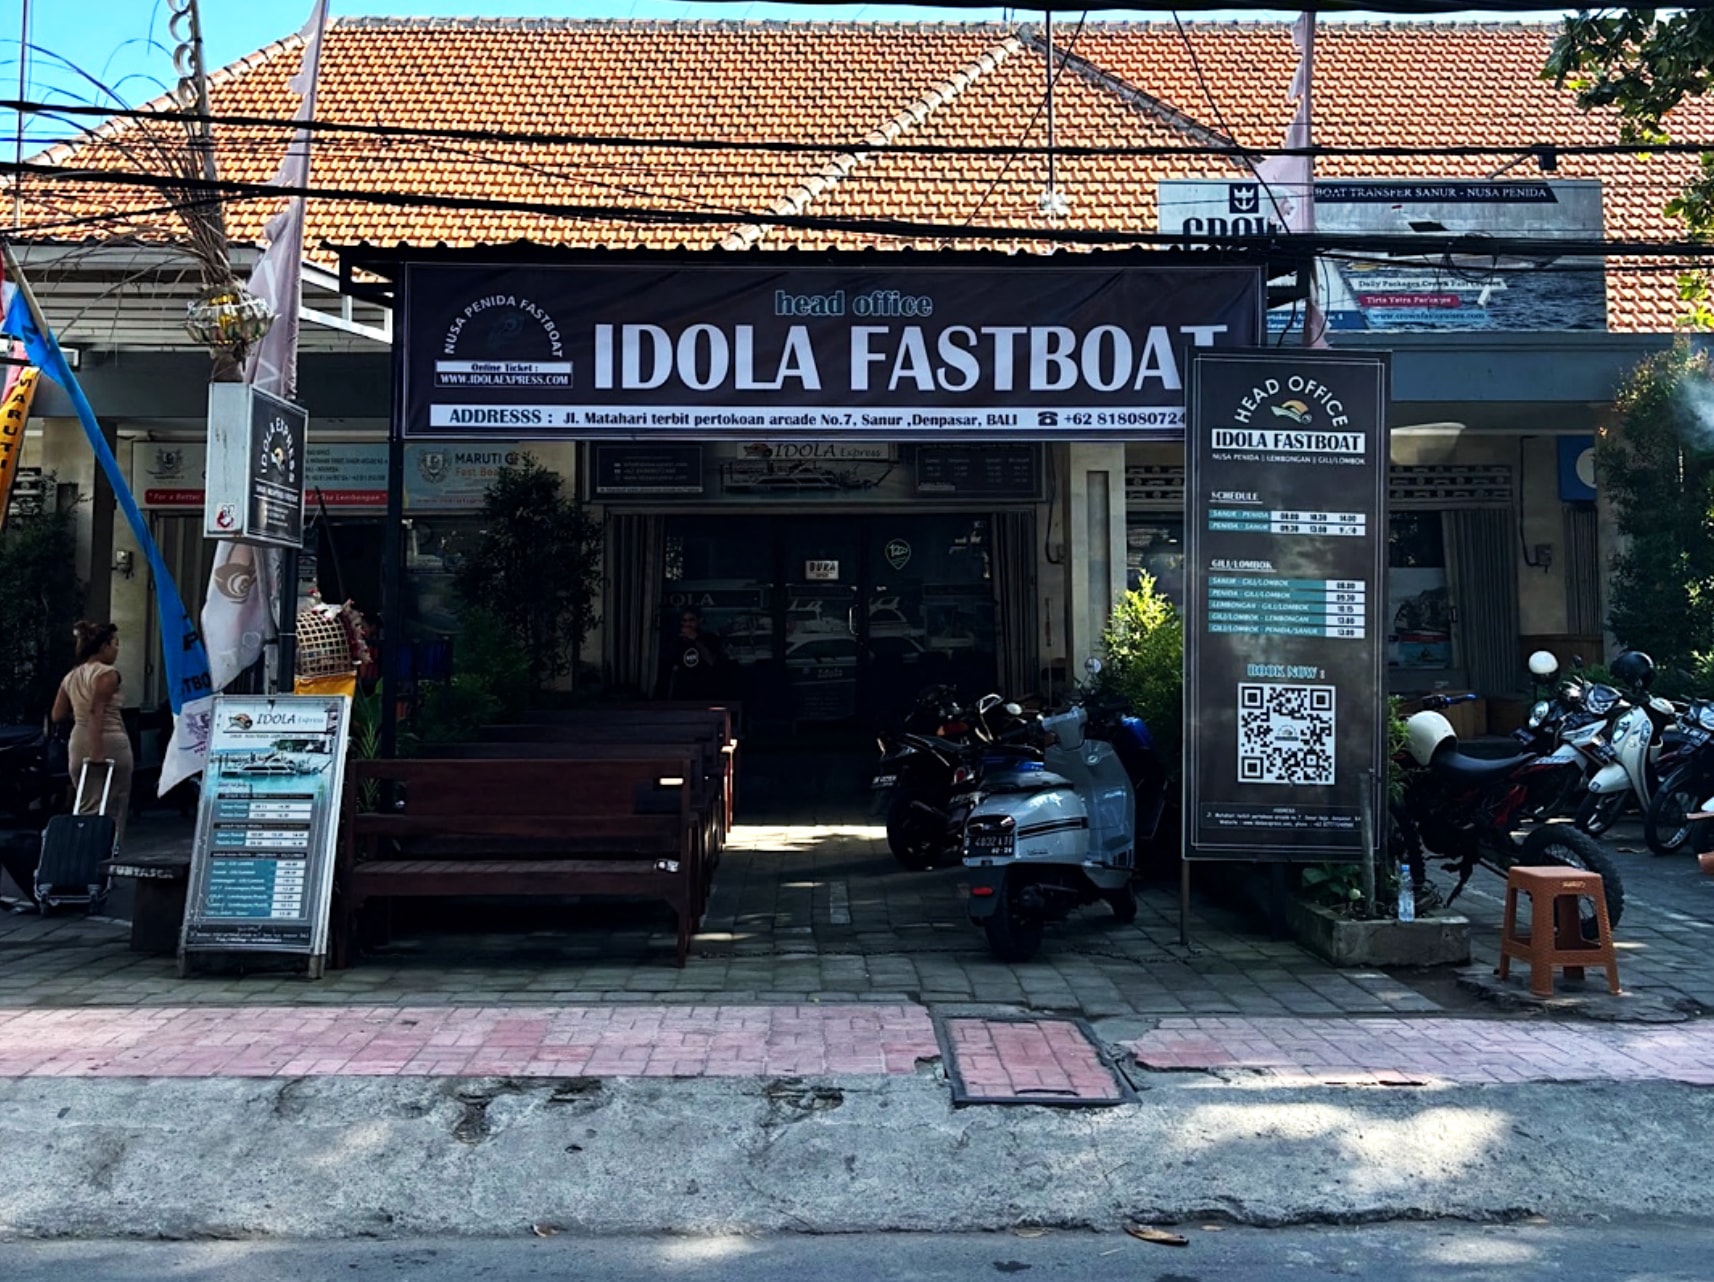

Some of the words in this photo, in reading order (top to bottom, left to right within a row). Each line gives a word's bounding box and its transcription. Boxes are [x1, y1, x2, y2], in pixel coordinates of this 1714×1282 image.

[1350, 187, 1412, 197] TRANSFER
[1415, 187, 1457, 197] SANUR
[1467, 187, 1499, 198] NUSA
[1502, 187, 1547, 198] PENIDA
[775, 290, 845, 317] head
[852, 290, 934, 317] office
[443, 316, 467, 355] NUSA
[464, 294, 516, 318] PENIDA
[518, 298, 563, 358] FASTBOAT
[594, 323, 822, 391] IDOLA
[470, 363, 501, 372] Online
[505, 363, 533, 372] Ticket
[439, 373, 569, 385] WWW.IDOLAEXPRESS.COM
[1234, 378, 1280, 424] HEAD
[1288, 375, 1349, 428] OFFICE
[449, 409, 542, 424] ADDRESSS
[584, 412, 647, 425] Matahari
[651, 412, 689, 425] terbit
[694, 413, 765, 428] pertokoan
[769, 413, 817, 425] arcade
[861, 414, 903, 426] Sanur
[986, 414, 1018, 426] BALI
[1063, 413, 1092, 425] +62
[1215, 430, 1268, 448] IDOLA
[1273, 432, 1361, 451] FASTBOAT
[775, 443, 836, 458] IDOLA
[455, 452, 501, 465] MARUTI
[1233, 454, 1260, 462] PENIDA
[1266, 455, 1311, 464] LEMBONGAN
[1211, 491, 1259, 501] SCHEDULE
[1246, 663, 1286, 678] BOOK
[1287, 665, 1318, 679] NOW
[256, 712, 297, 726] IDOLA
